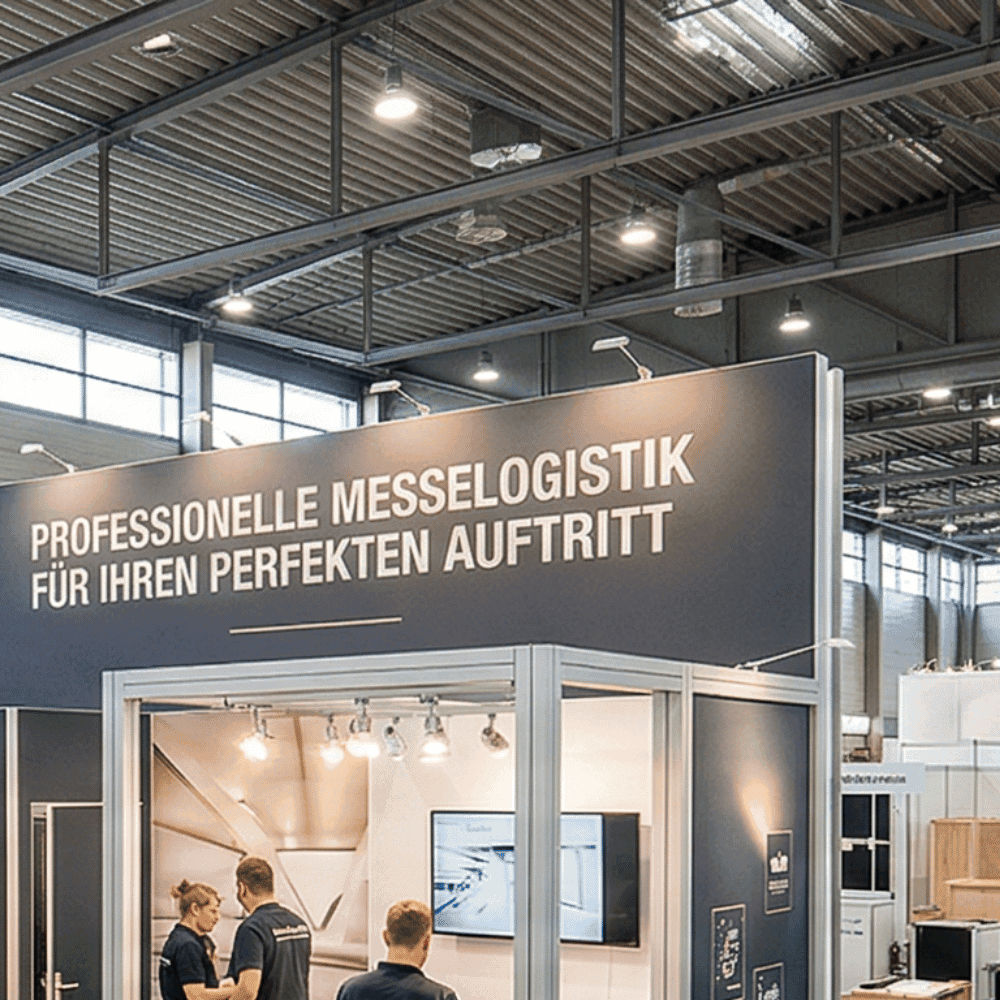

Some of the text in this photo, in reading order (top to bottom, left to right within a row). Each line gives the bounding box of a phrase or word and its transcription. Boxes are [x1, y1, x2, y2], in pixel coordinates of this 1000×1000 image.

[31, 433, 696, 561] PROFESSIONELLE MESSELOGISTIK
[31, 502, 674, 610] FÜR IHREN PERFEKTEN AUFTRITT
